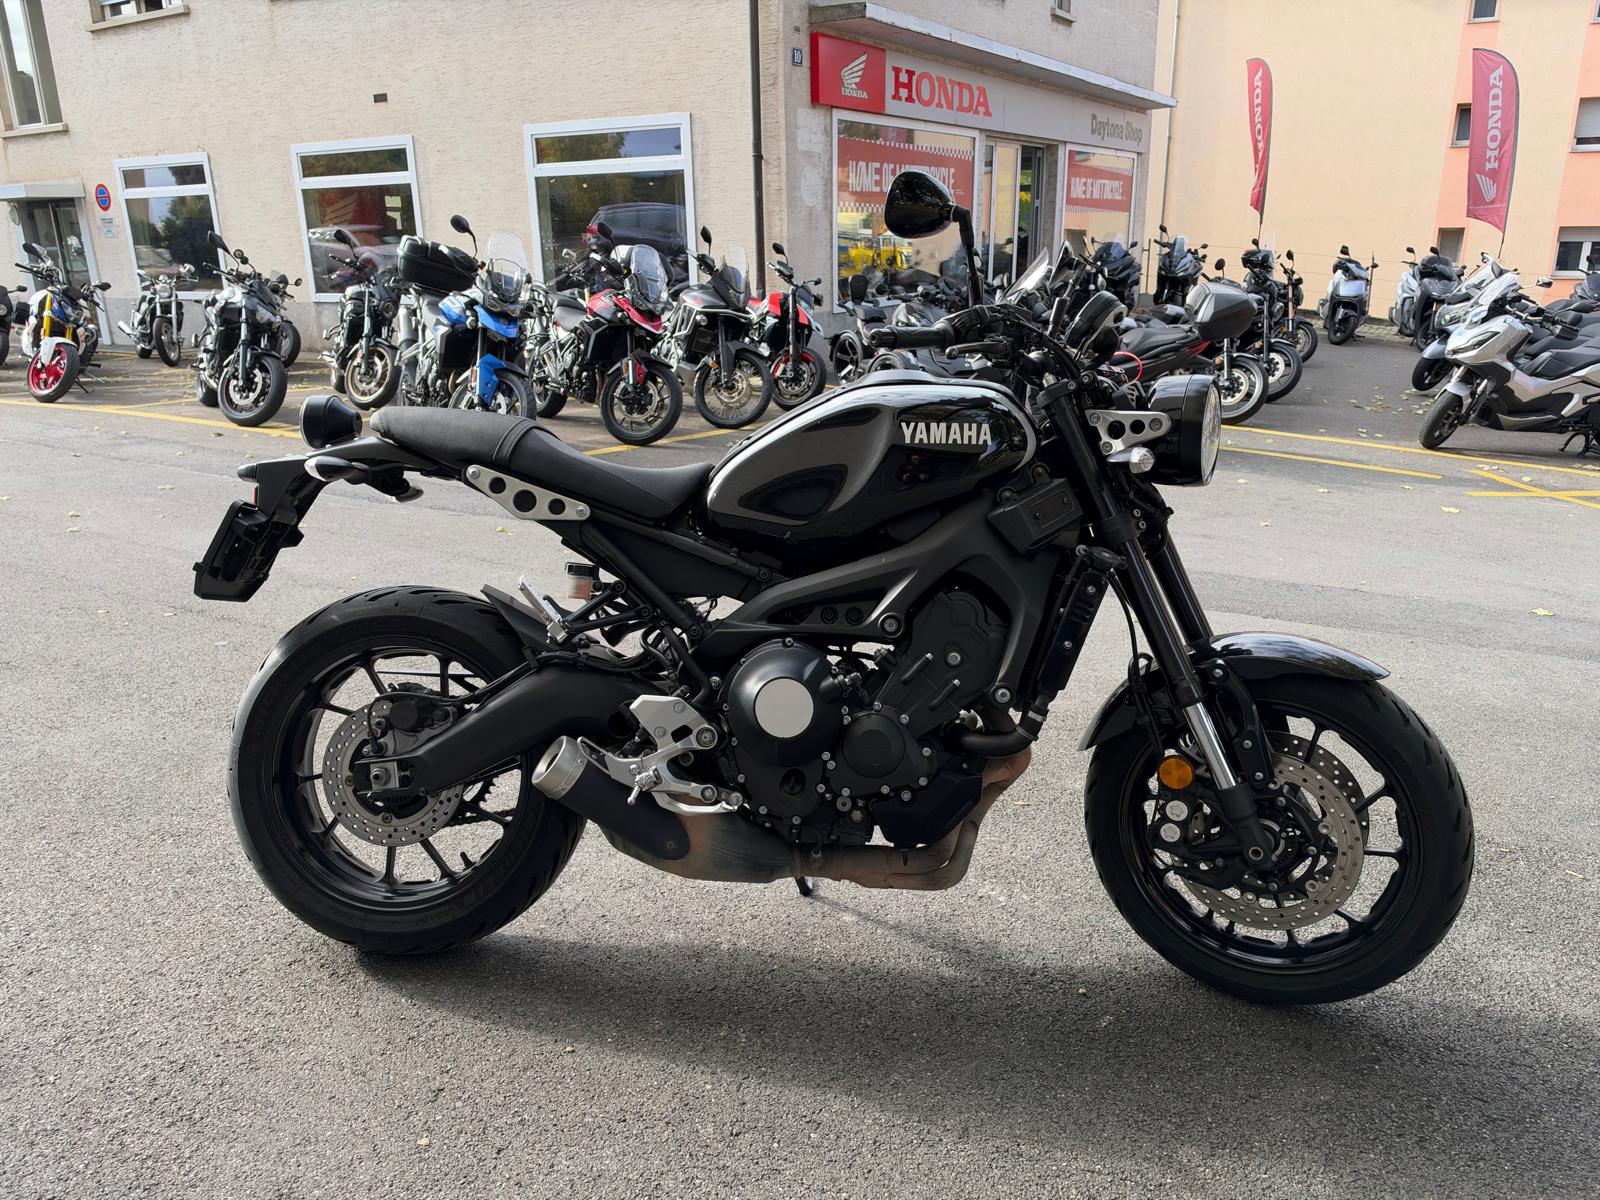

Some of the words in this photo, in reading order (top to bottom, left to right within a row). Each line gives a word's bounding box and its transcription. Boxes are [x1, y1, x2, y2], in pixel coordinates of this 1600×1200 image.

[793, 49, 802, 64] 10
[841, 87, 868, 99] HONDA
[891, 65, 992, 117] HONDA
[1091, 113, 1124, 141] Daytona
[1125, 120, 1143, 147] Shop
[1485, 64, 1504, 171] HONDA
[848, 160, 881, 193] HOME
[900, 421, 992, 446] YAMAHA
